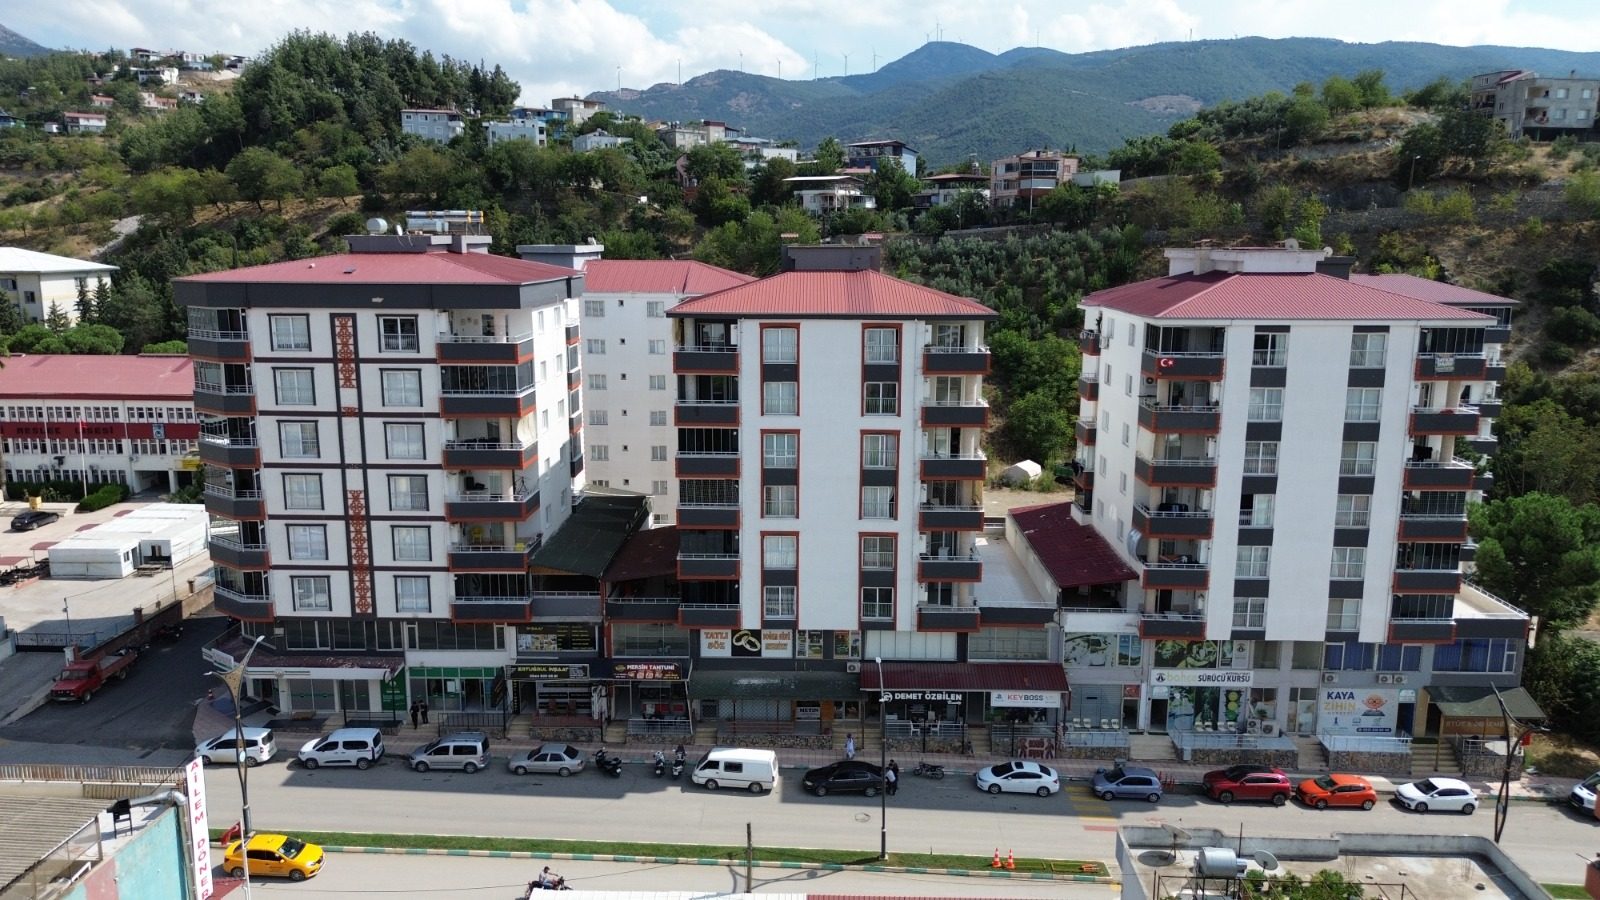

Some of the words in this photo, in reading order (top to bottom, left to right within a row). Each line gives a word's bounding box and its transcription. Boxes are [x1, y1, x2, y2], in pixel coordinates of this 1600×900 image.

[1198, 673, 1226, 682] SÜRÜCÜ
[1226, 675, 1250, 683] KURSU
[894, 692, 923, 700] DEMET
[925, 690, 962, 701] ÖZBİLEN
[1327, 691, 1355, 700] KAYA
[190, 761, 204, 825] AİLEM
[197, 838, 211, 900] DÖNER
